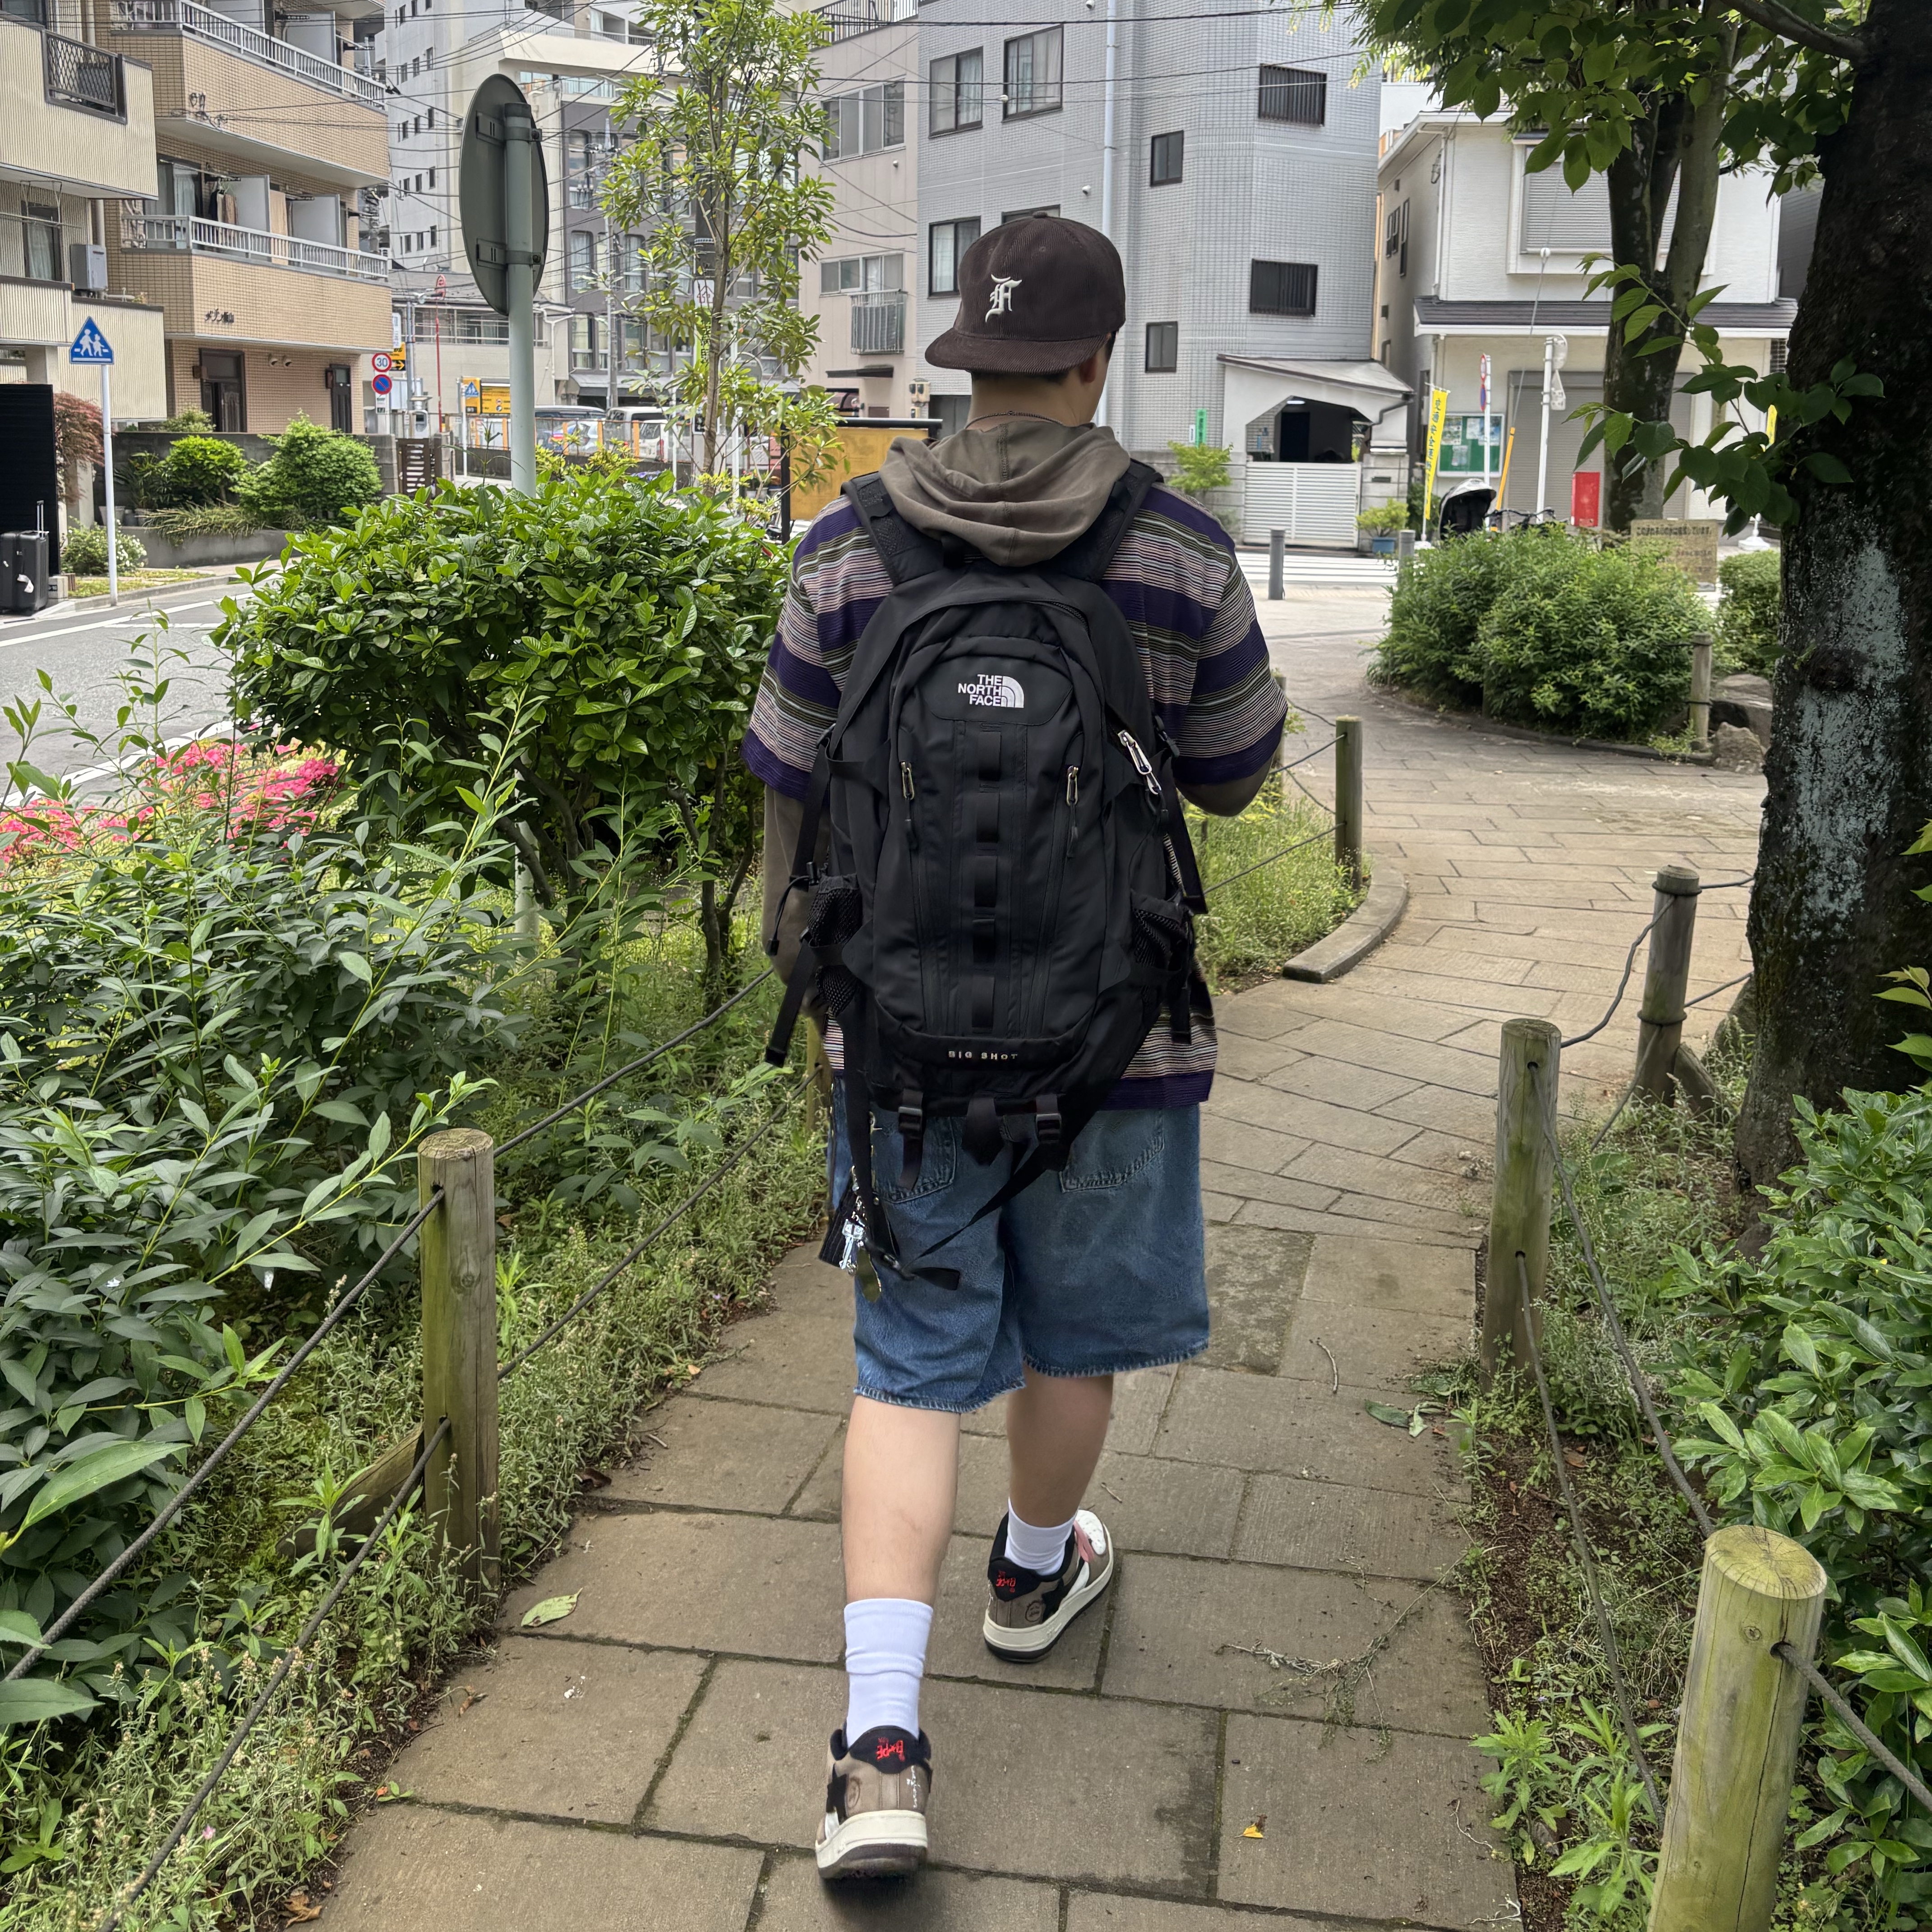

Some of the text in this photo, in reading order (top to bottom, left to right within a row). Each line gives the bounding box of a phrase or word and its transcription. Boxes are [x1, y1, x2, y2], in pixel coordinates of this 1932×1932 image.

[376, 358, 388, 367] 30
[977, 674, 1002, 685] THE
[958, 683, 1001, 696] NORTH
[969, 695, 1001, 706] FACE
